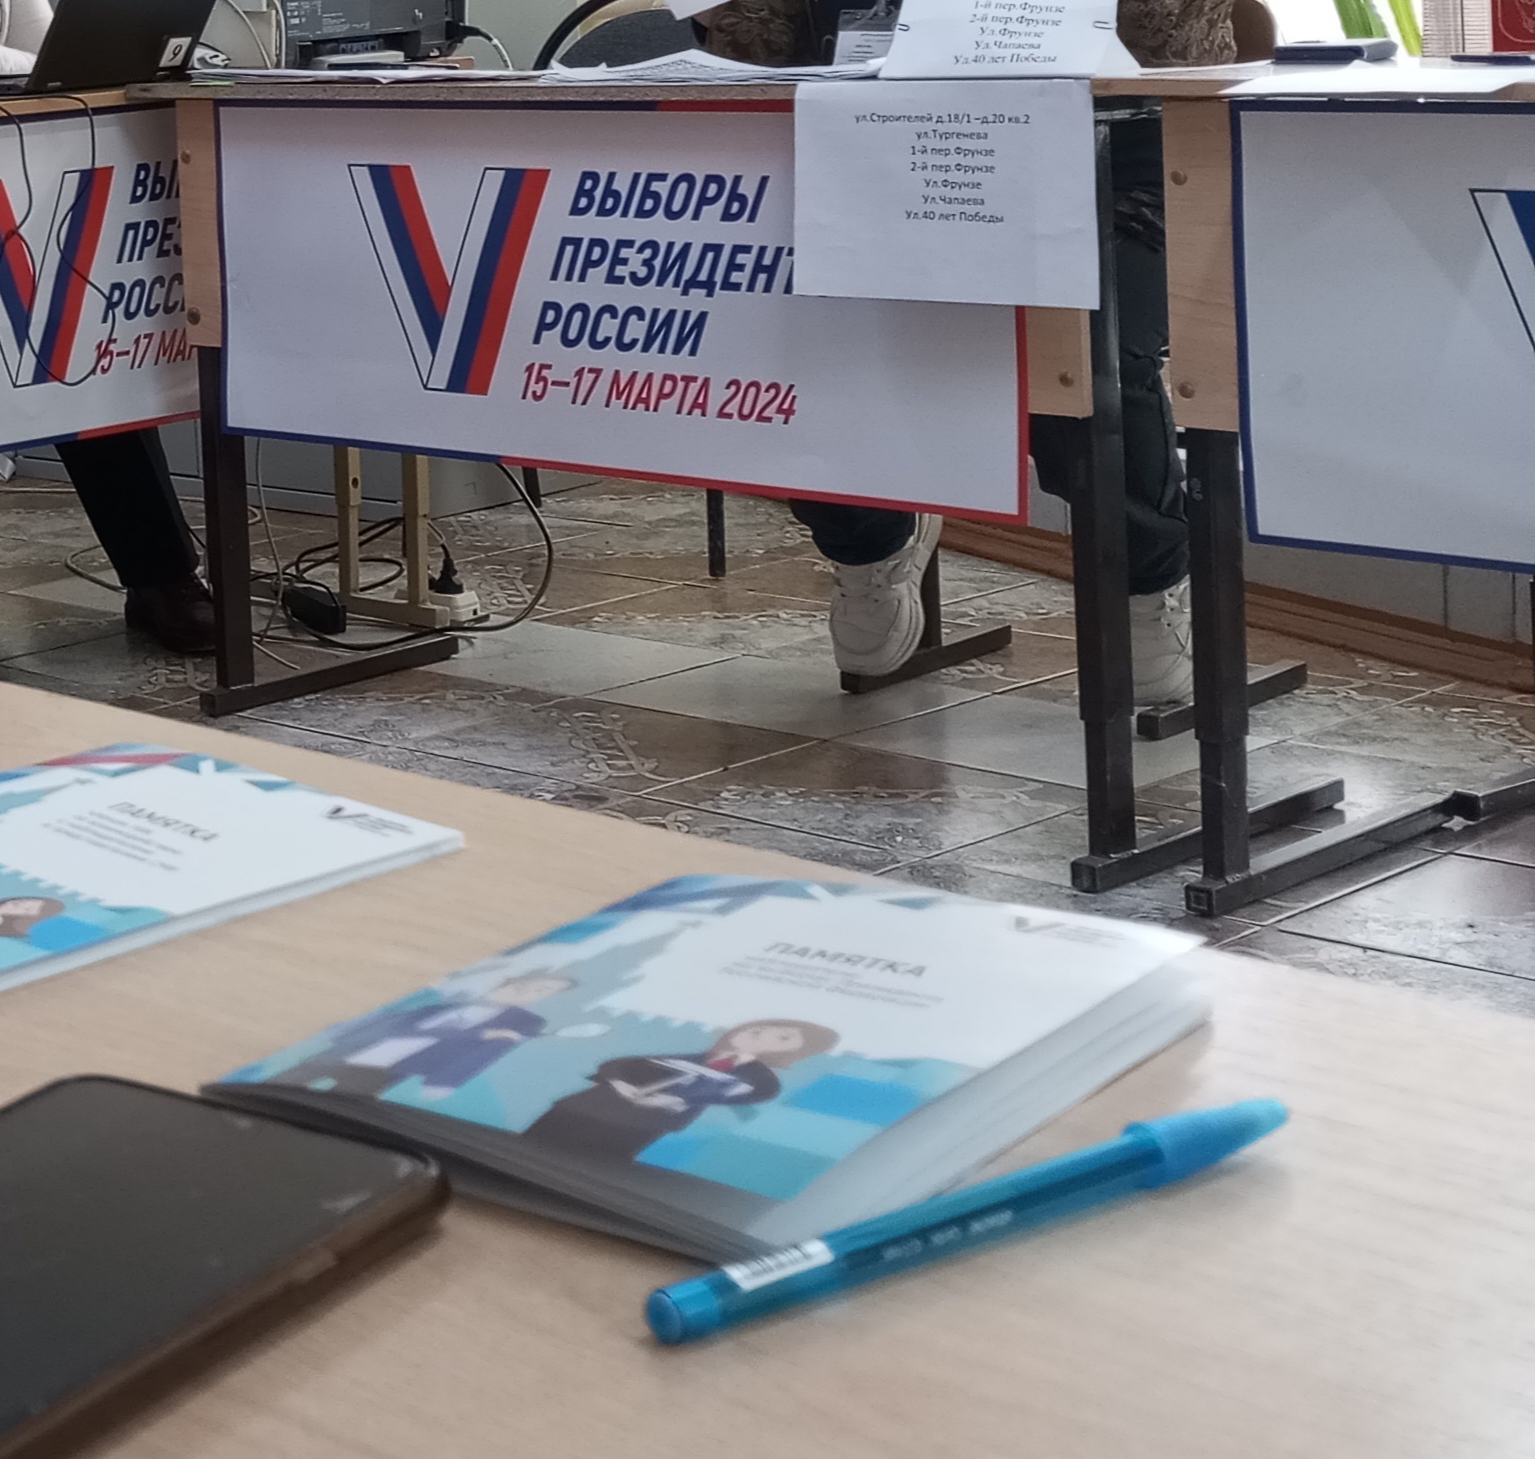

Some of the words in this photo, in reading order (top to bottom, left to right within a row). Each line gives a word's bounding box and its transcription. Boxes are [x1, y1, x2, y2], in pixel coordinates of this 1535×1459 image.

[974, 1, 992, 10] 1-й
[994, 2, 1065, 15] пер.Фрунзе
[969, 13, 988, 23] 2-й
[991, 14, 1062, 27] пер.Фрунзе
[987, 55, 1007, 64] лет
[1009, 53, 1057, 64] Победы
[854, 112, 933, 124] ул.Строителей
[915, 129, 988, 141] ул.Тургенева
[910, 145, 928, 156] 1-й
[930, 147, 995, 158] пер.Фрунзе
[910, 161, 928, 172] 2-й
[930, 163, 996, 175] пер.Фрунзе
[129, 159, 180, 205] ВЫ
[923, 178, 983, 191] Ул.Фрунзе
[568, 169, 770, 224] ВЫБОРЫ
[922, 194, 985, 206] Ул.Чапаева
[905, 210, 936, 221] Ул.40
[938, 212, 957, 221] лет
[959, 211, 1005, 223] Победы
[101, 272, 186, 325] РОСС
[532, 300, 710, 357] РОССИИ
[521, 362, 603, 407] 15–17
[605, 368, 712, 418] МАРТА
[716, 377, 798, 425] 2024
[107, 801, 220, 842] ПАМЯТКА
[763, 941, 928, 978] ПАМЯТКА
